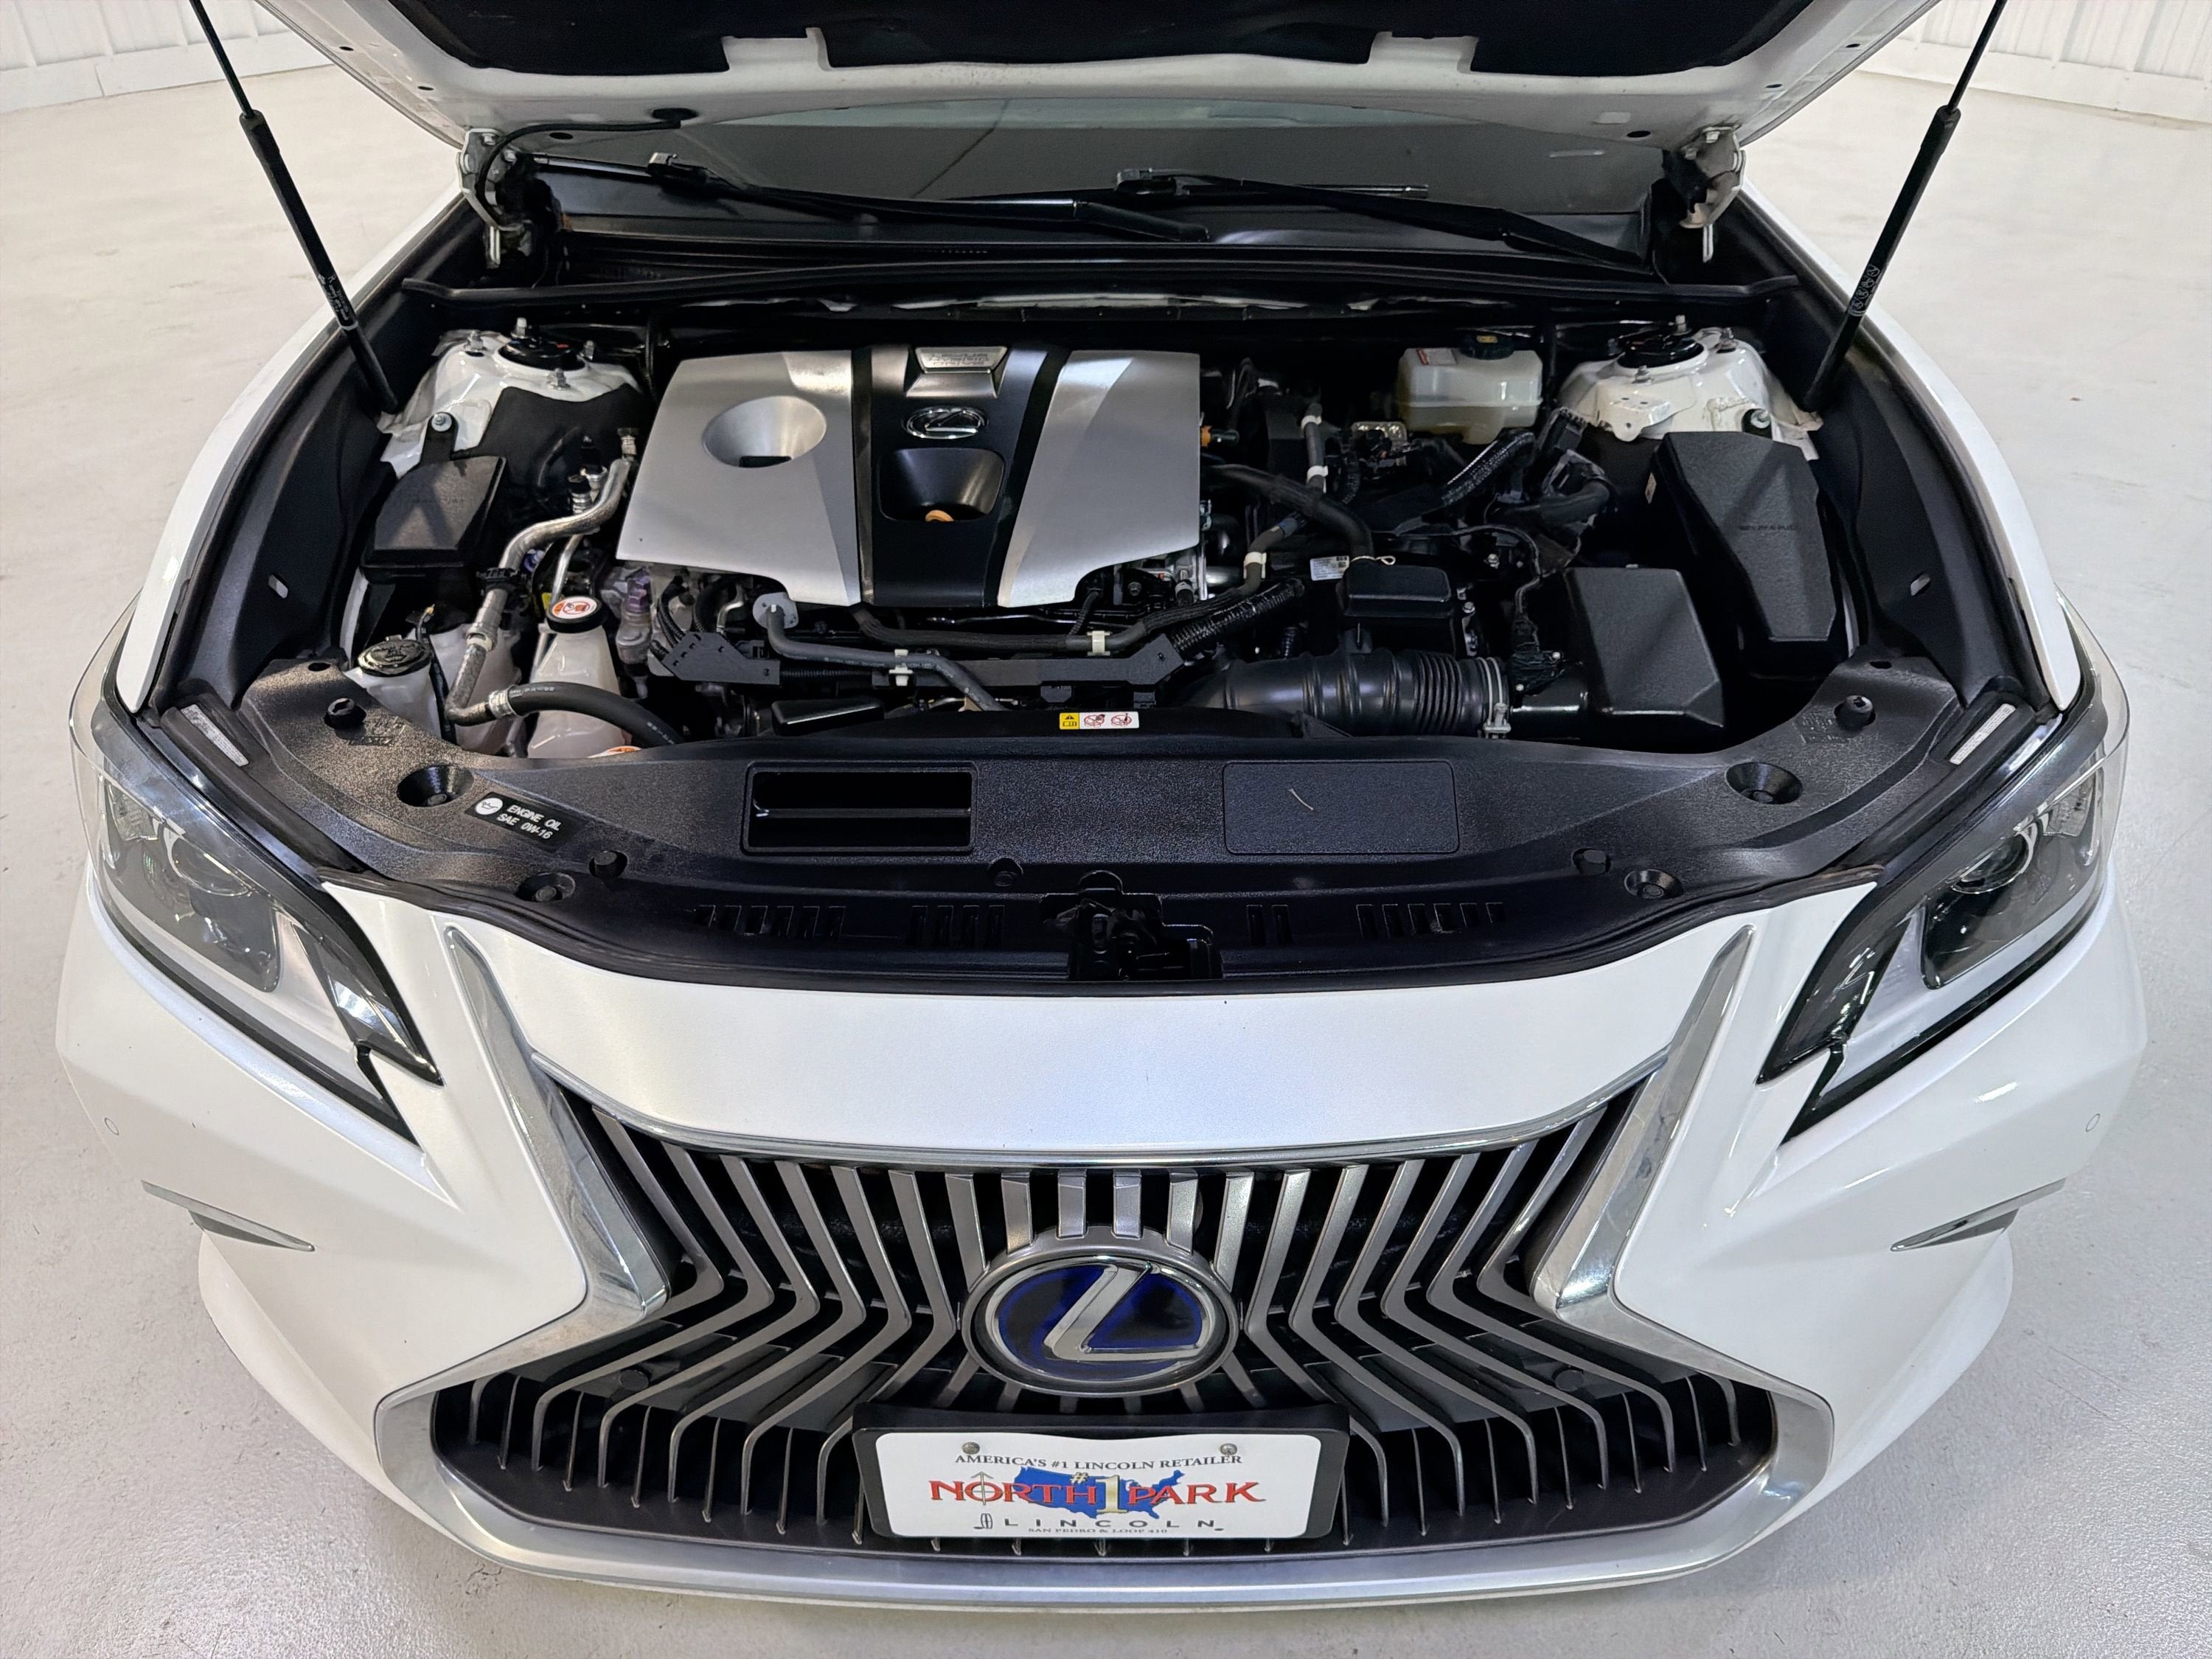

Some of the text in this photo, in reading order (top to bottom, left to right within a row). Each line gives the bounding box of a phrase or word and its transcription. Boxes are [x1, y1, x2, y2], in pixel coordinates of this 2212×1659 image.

[497, 813, 554, 839] SAE 0W-16
[507, 804, 563, 831] ENGINE OIL
[955, 1455, 1243, 1470] AMERICA'S #1 LINCOLN RETAILER
[928, 1480, 1097, 1506] NORTH
[1128, 1482, 1267, 1505] PARK
[1004, 1518, 1214, 1528] LINCOLN
